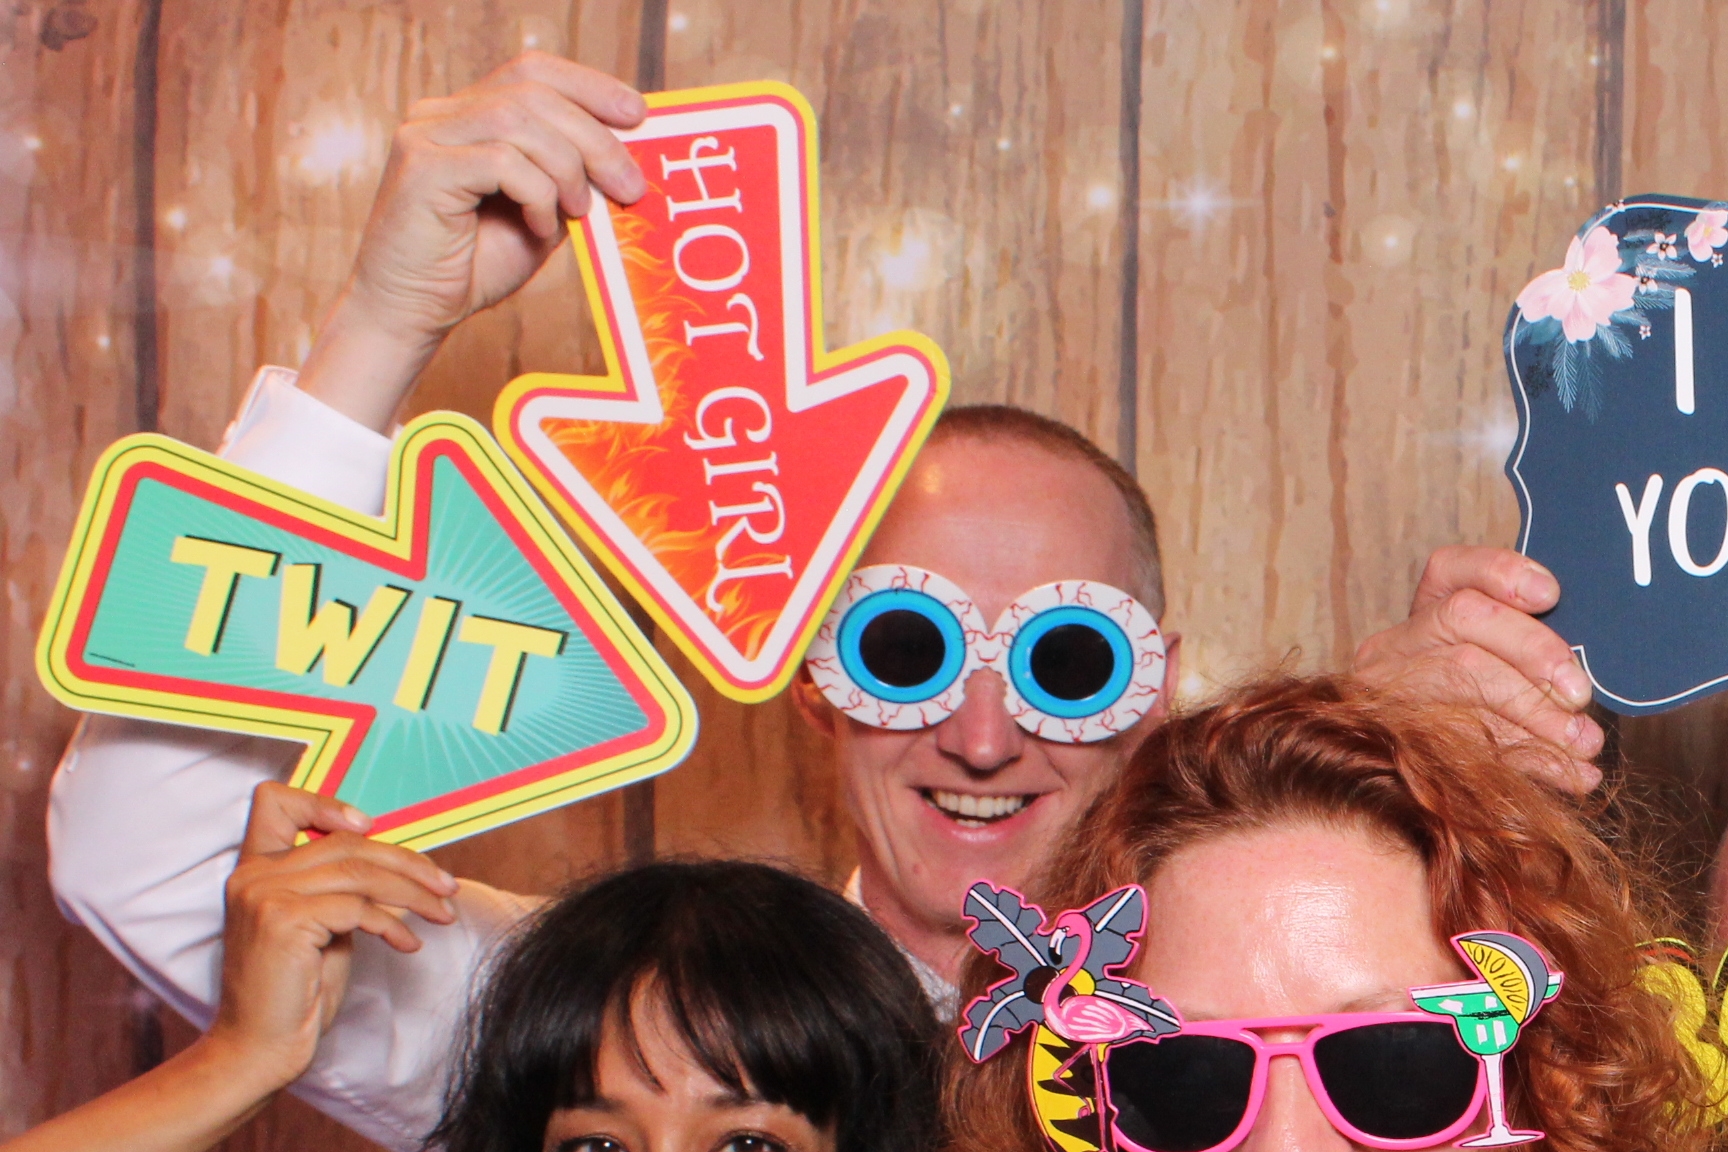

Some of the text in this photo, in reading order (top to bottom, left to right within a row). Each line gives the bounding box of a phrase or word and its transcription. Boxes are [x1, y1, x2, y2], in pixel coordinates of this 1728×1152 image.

[661, 134, 794, 614] HOT GIRL
[1675, 288, 1694, 415] I
[170, 534, 568, 737] TWIT
